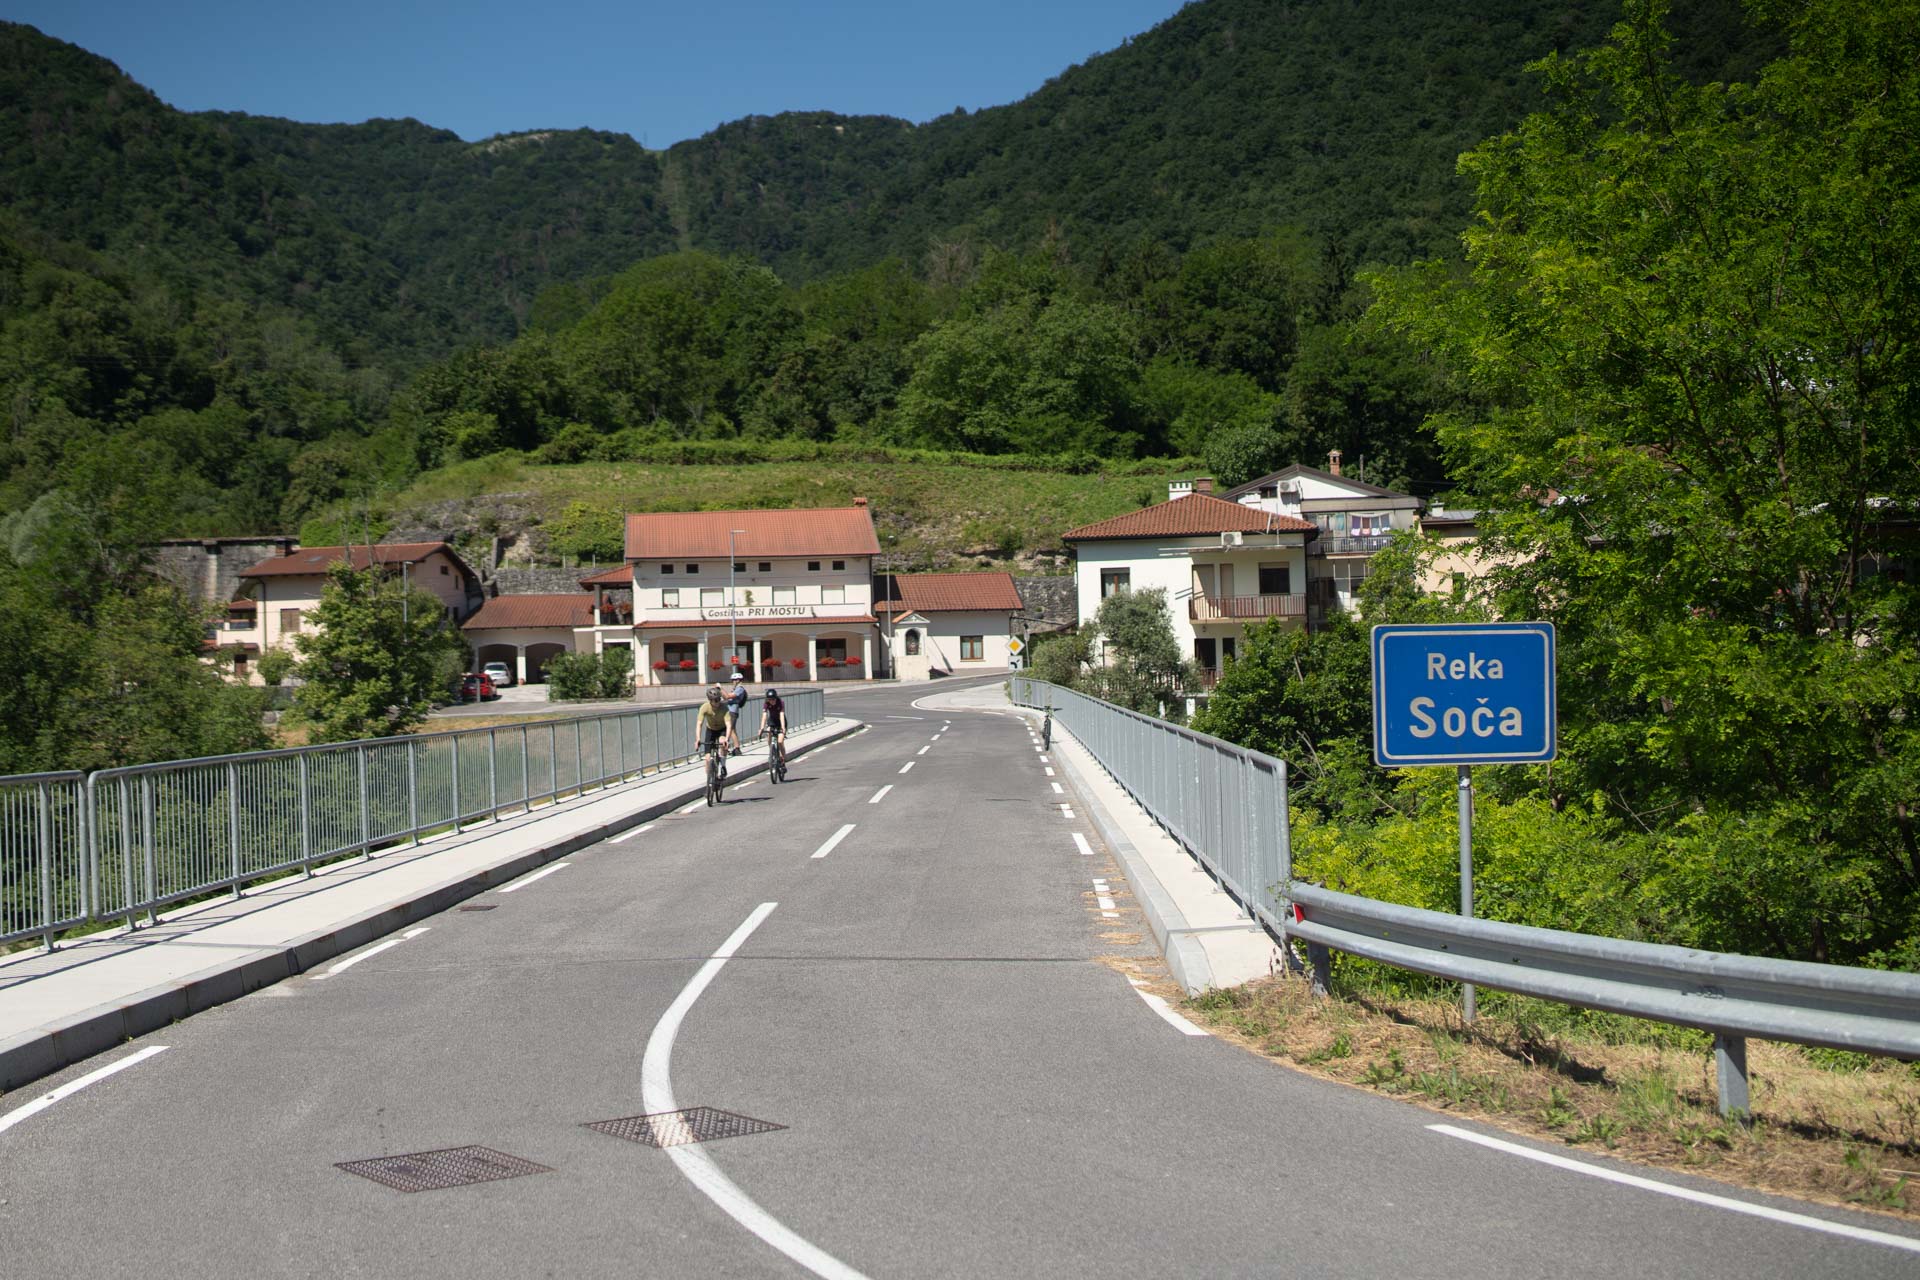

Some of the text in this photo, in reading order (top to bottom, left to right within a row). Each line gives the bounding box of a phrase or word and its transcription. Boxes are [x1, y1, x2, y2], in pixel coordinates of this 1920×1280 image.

[748, 608, 765, 616] PRI
[769, 607, 806, 616] MOSTU
[1427, 652, 1504, 680] Reka
[1409, 696, 1523, 738] Soča
